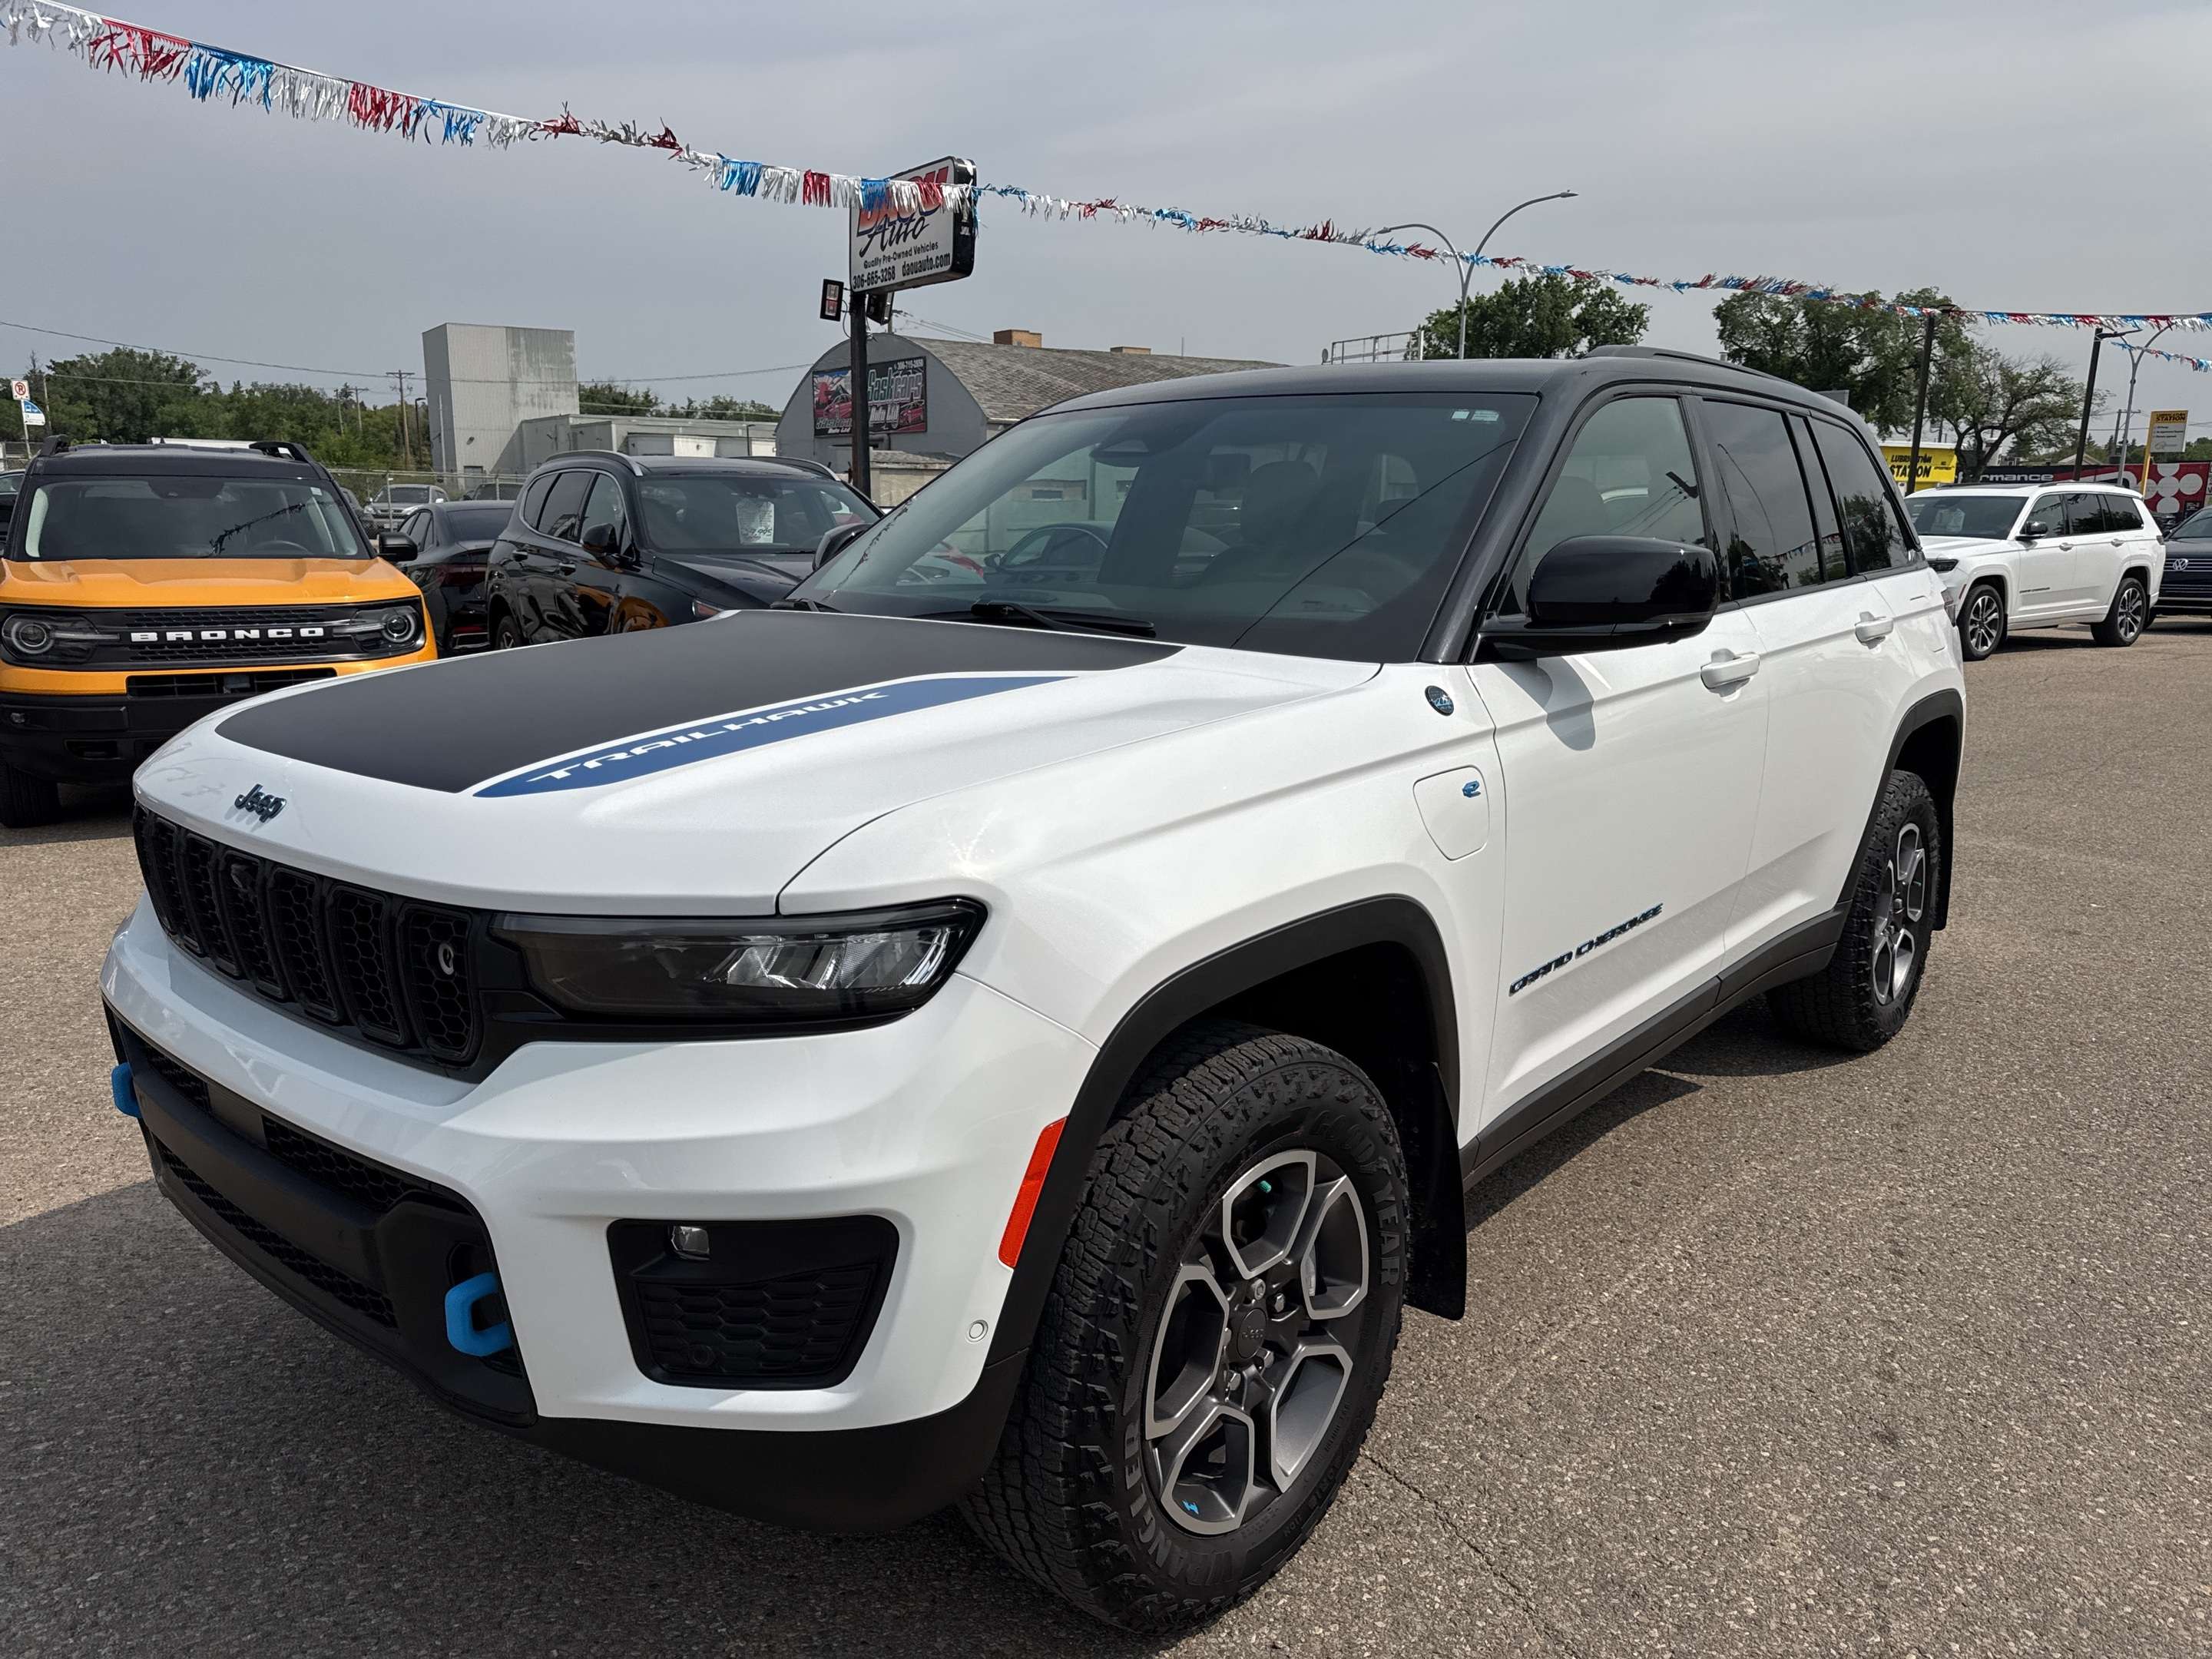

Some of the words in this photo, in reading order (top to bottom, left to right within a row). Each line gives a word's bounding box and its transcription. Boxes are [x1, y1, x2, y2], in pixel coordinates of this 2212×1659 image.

[859, 213, 929, 258] Auto
[882, 247, 912, 263] Pre-Owned
[913, 241, 939, 255] Vehicles
[853, 266, 896, 289] 306-665-3268
[902, 252, 951, 276] daouauto.com
[1889, 465, 1932, 478] STAON
[131, 628, 324, 642] BRONCO
[526, 692, 889, 782] TRAILHAWK
[234, 783, 287, 823] Jeep
[1508, 951, 1574, 997] GRAND
[1575, 902, 1664, 959] CHEROKEE
